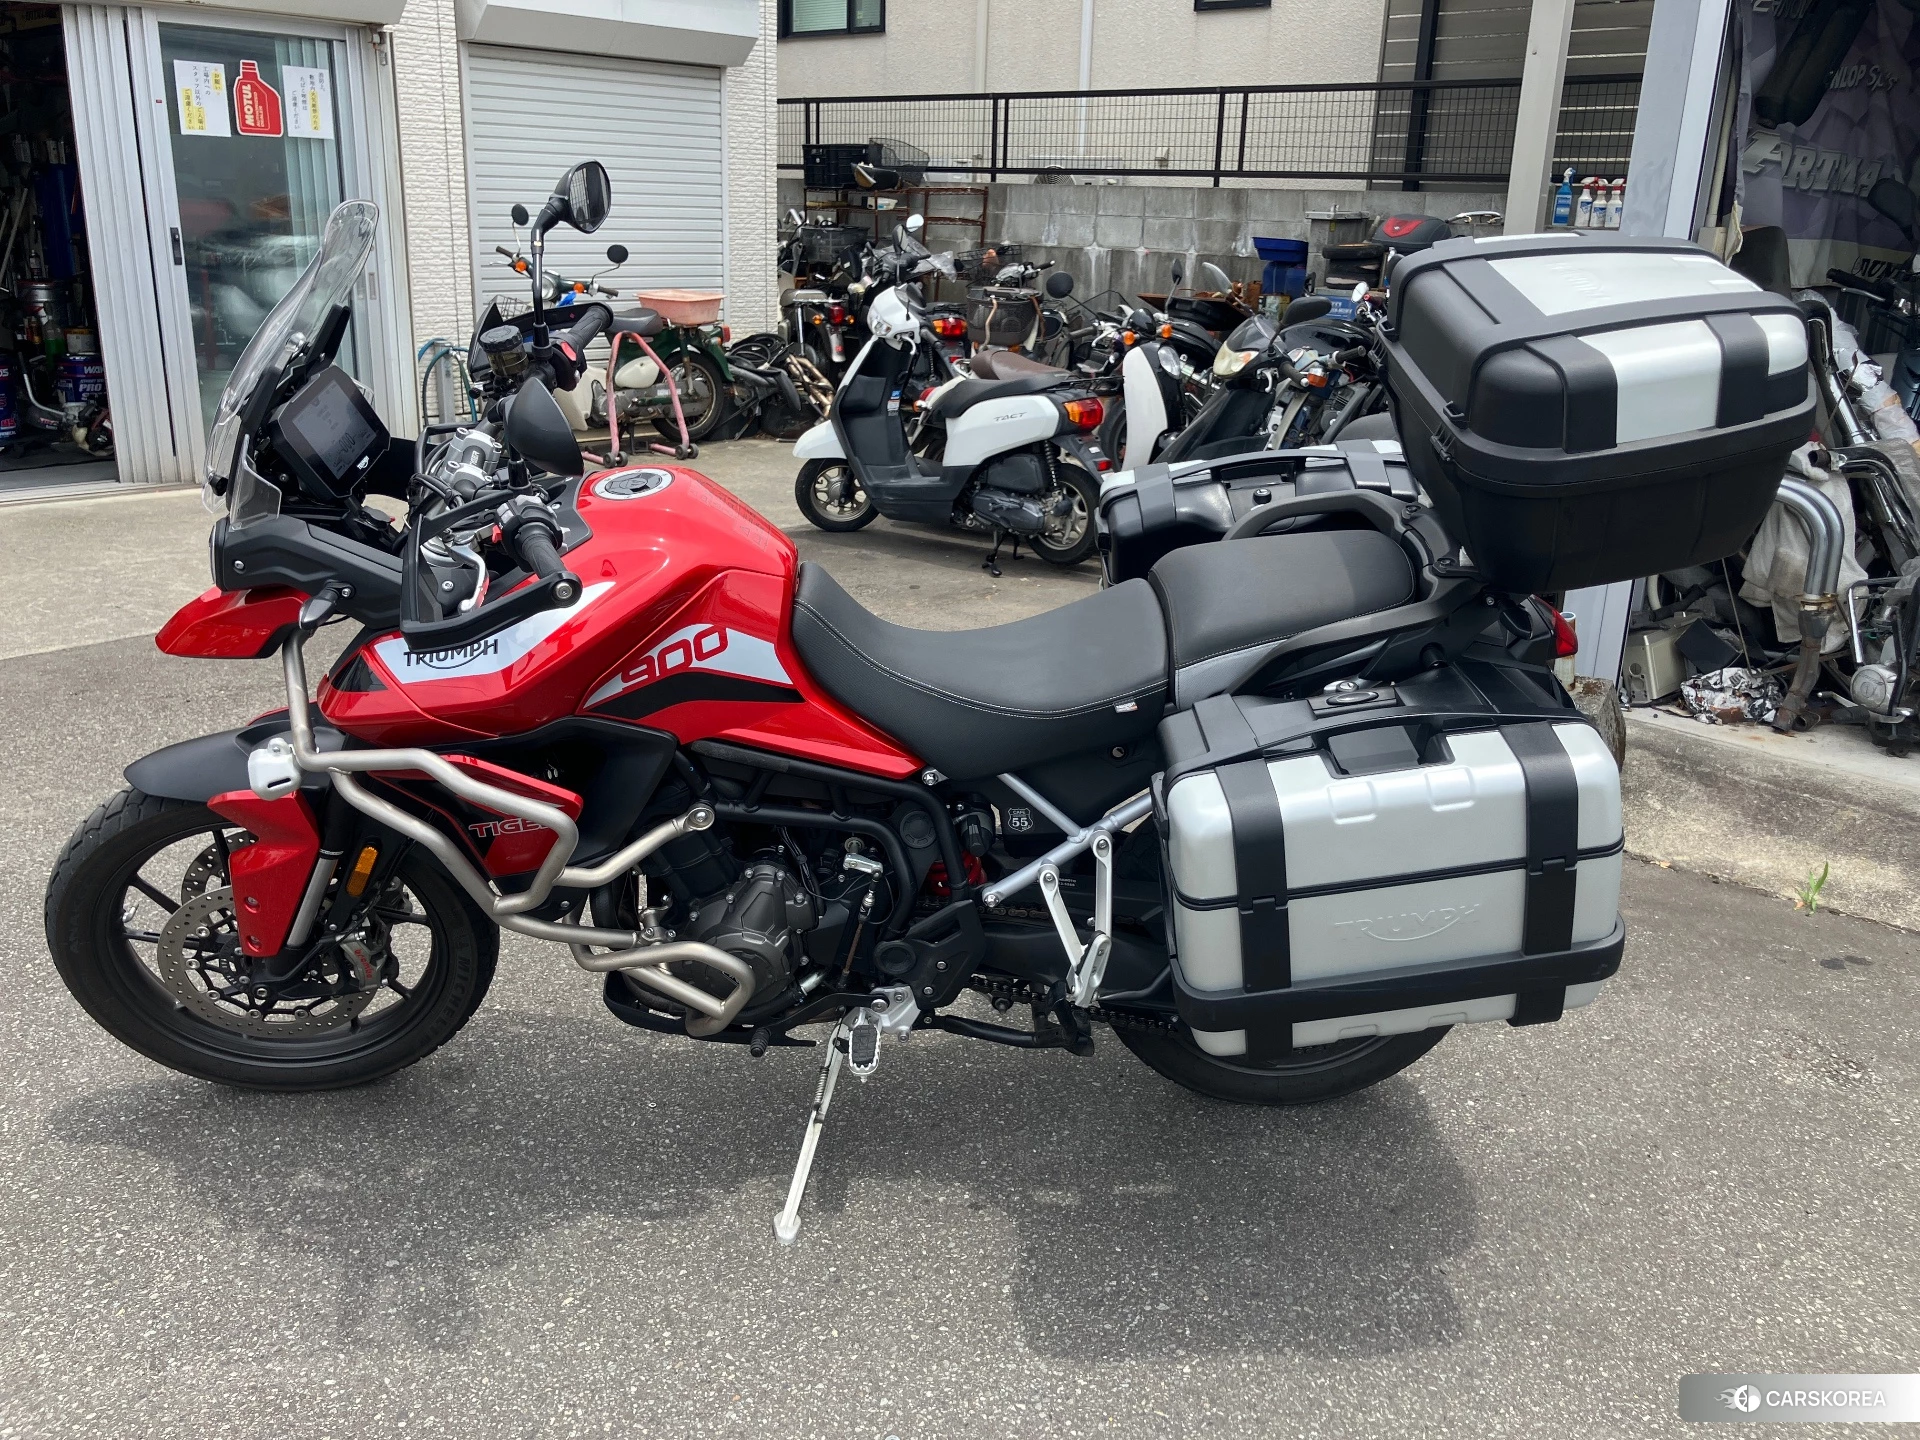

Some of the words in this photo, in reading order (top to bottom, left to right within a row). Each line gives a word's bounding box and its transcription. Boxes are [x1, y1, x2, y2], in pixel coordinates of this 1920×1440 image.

[242, 84, 255, 127] MOTUL
[993, 411, 1027, 421] TACT
[620, 625, 728, 692] 900
[468, 818, 546, 838] TIGE
[1012, 817, 1029, 827] 55
